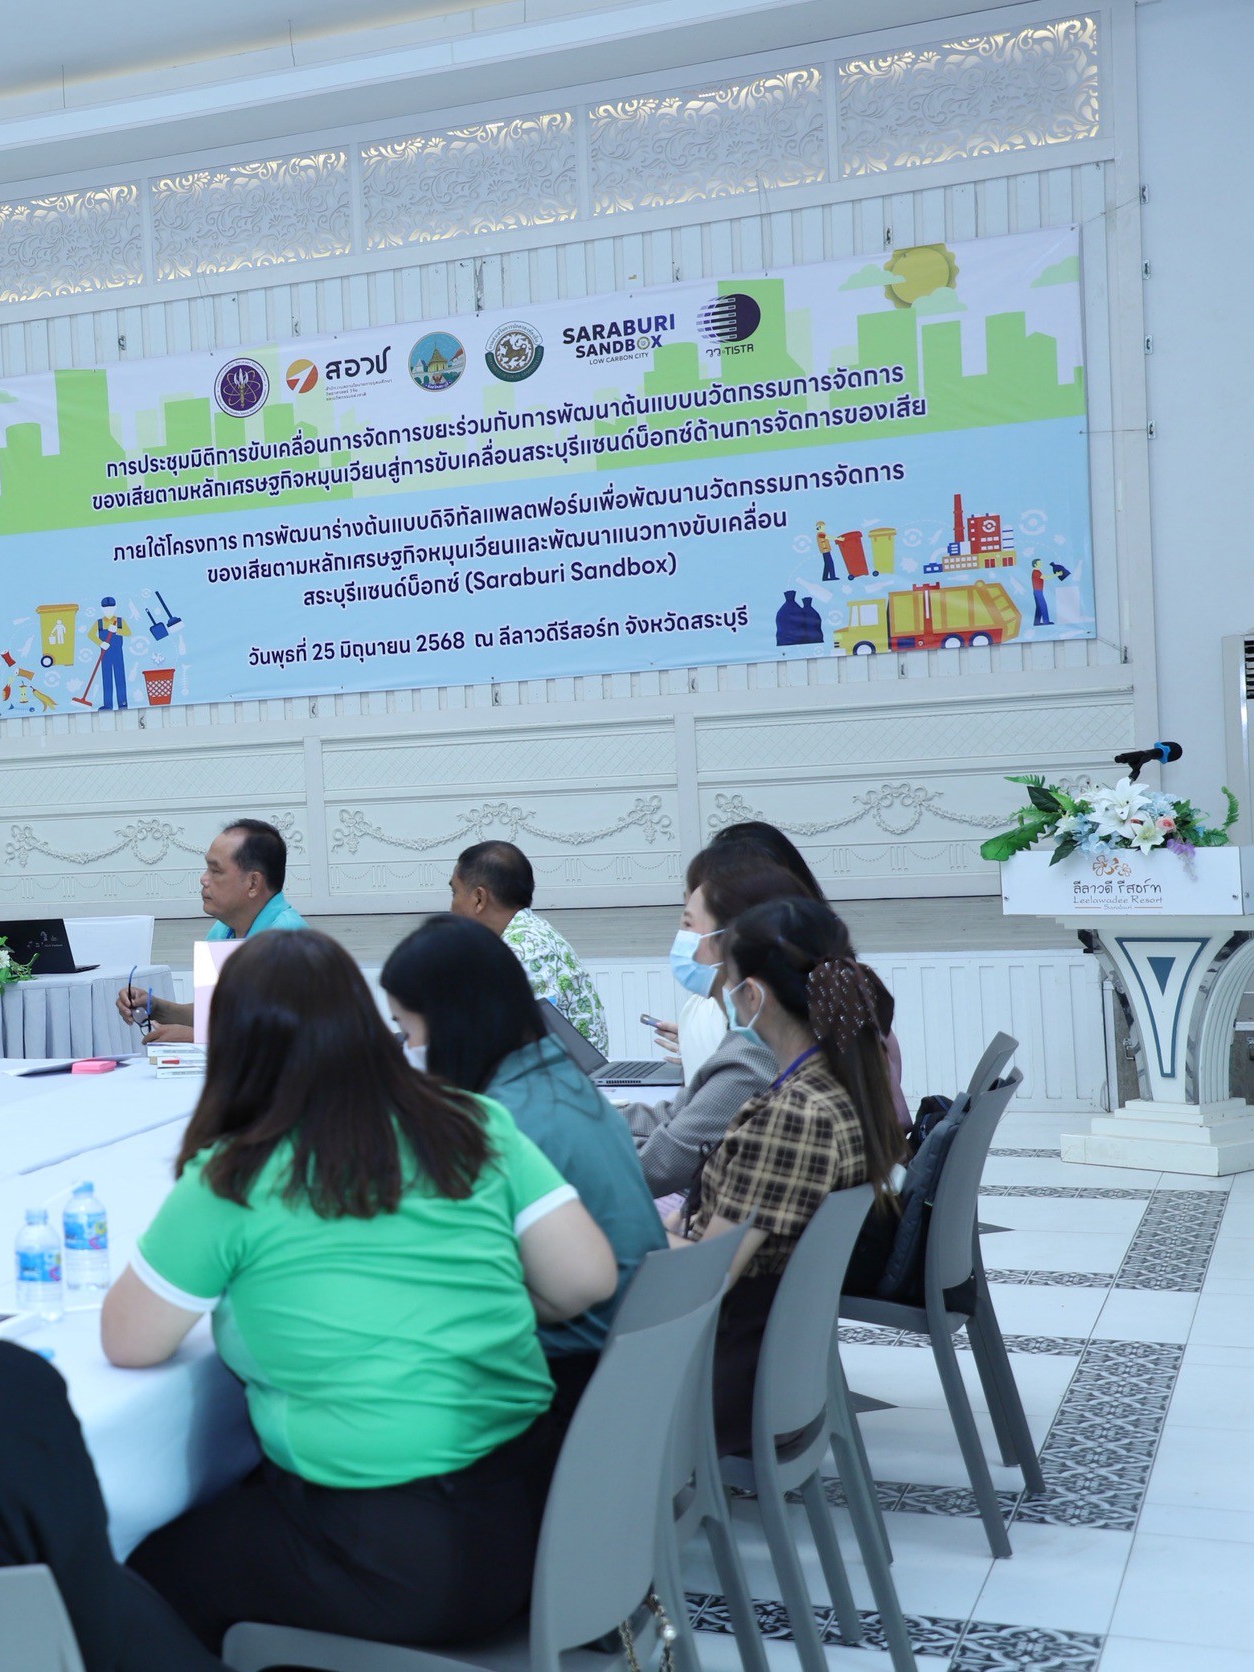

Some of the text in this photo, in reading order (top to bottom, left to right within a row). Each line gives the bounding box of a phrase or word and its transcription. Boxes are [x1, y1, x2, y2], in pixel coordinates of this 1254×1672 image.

[562, 313, 675, 345] SARABURI
[575, 334, 663, 359] SANDBOX
[589, 352, 650, 366] LOW CARBON CITY
[113, 533, 237, 562] ภายใต้โครงการ
[303, 551, 677, 609] สระบุรีแซนด์บ็อกซ์ (Saraburi Sandbox)
[248, 604, 749, 669] วันพุธที่ 25 มิถุนายน 2568 ณ ลีลาวดีรีสอร์ท จังหวัดสระบุรี
[1073, 878, 1162, 894] ลีลาวดี รีสอร์ท
[1073, 894, 1163, 904] Leelawadee Resort
